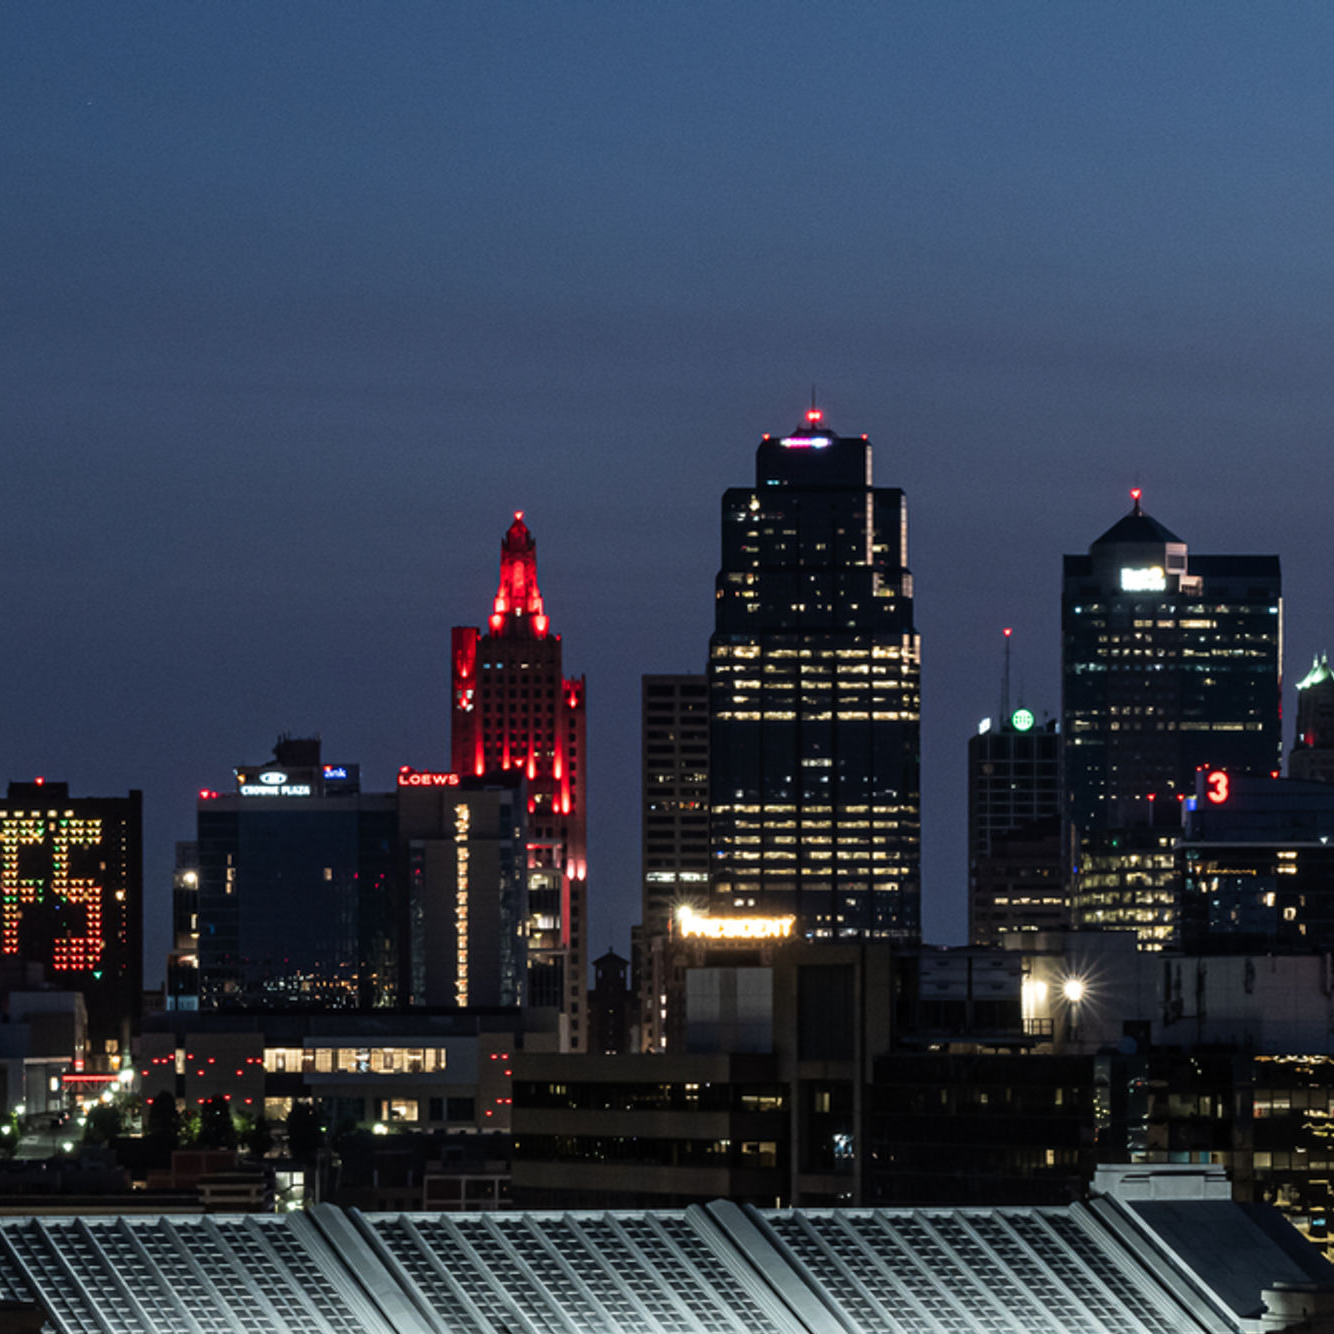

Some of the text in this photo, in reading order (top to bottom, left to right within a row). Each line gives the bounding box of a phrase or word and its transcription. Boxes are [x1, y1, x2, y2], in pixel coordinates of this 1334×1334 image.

[398, 773, 459, 786] LOEWS
[240, 785, 310, 796] CROWNE PLAZA
[1208, 771, 1229, 804] 3
